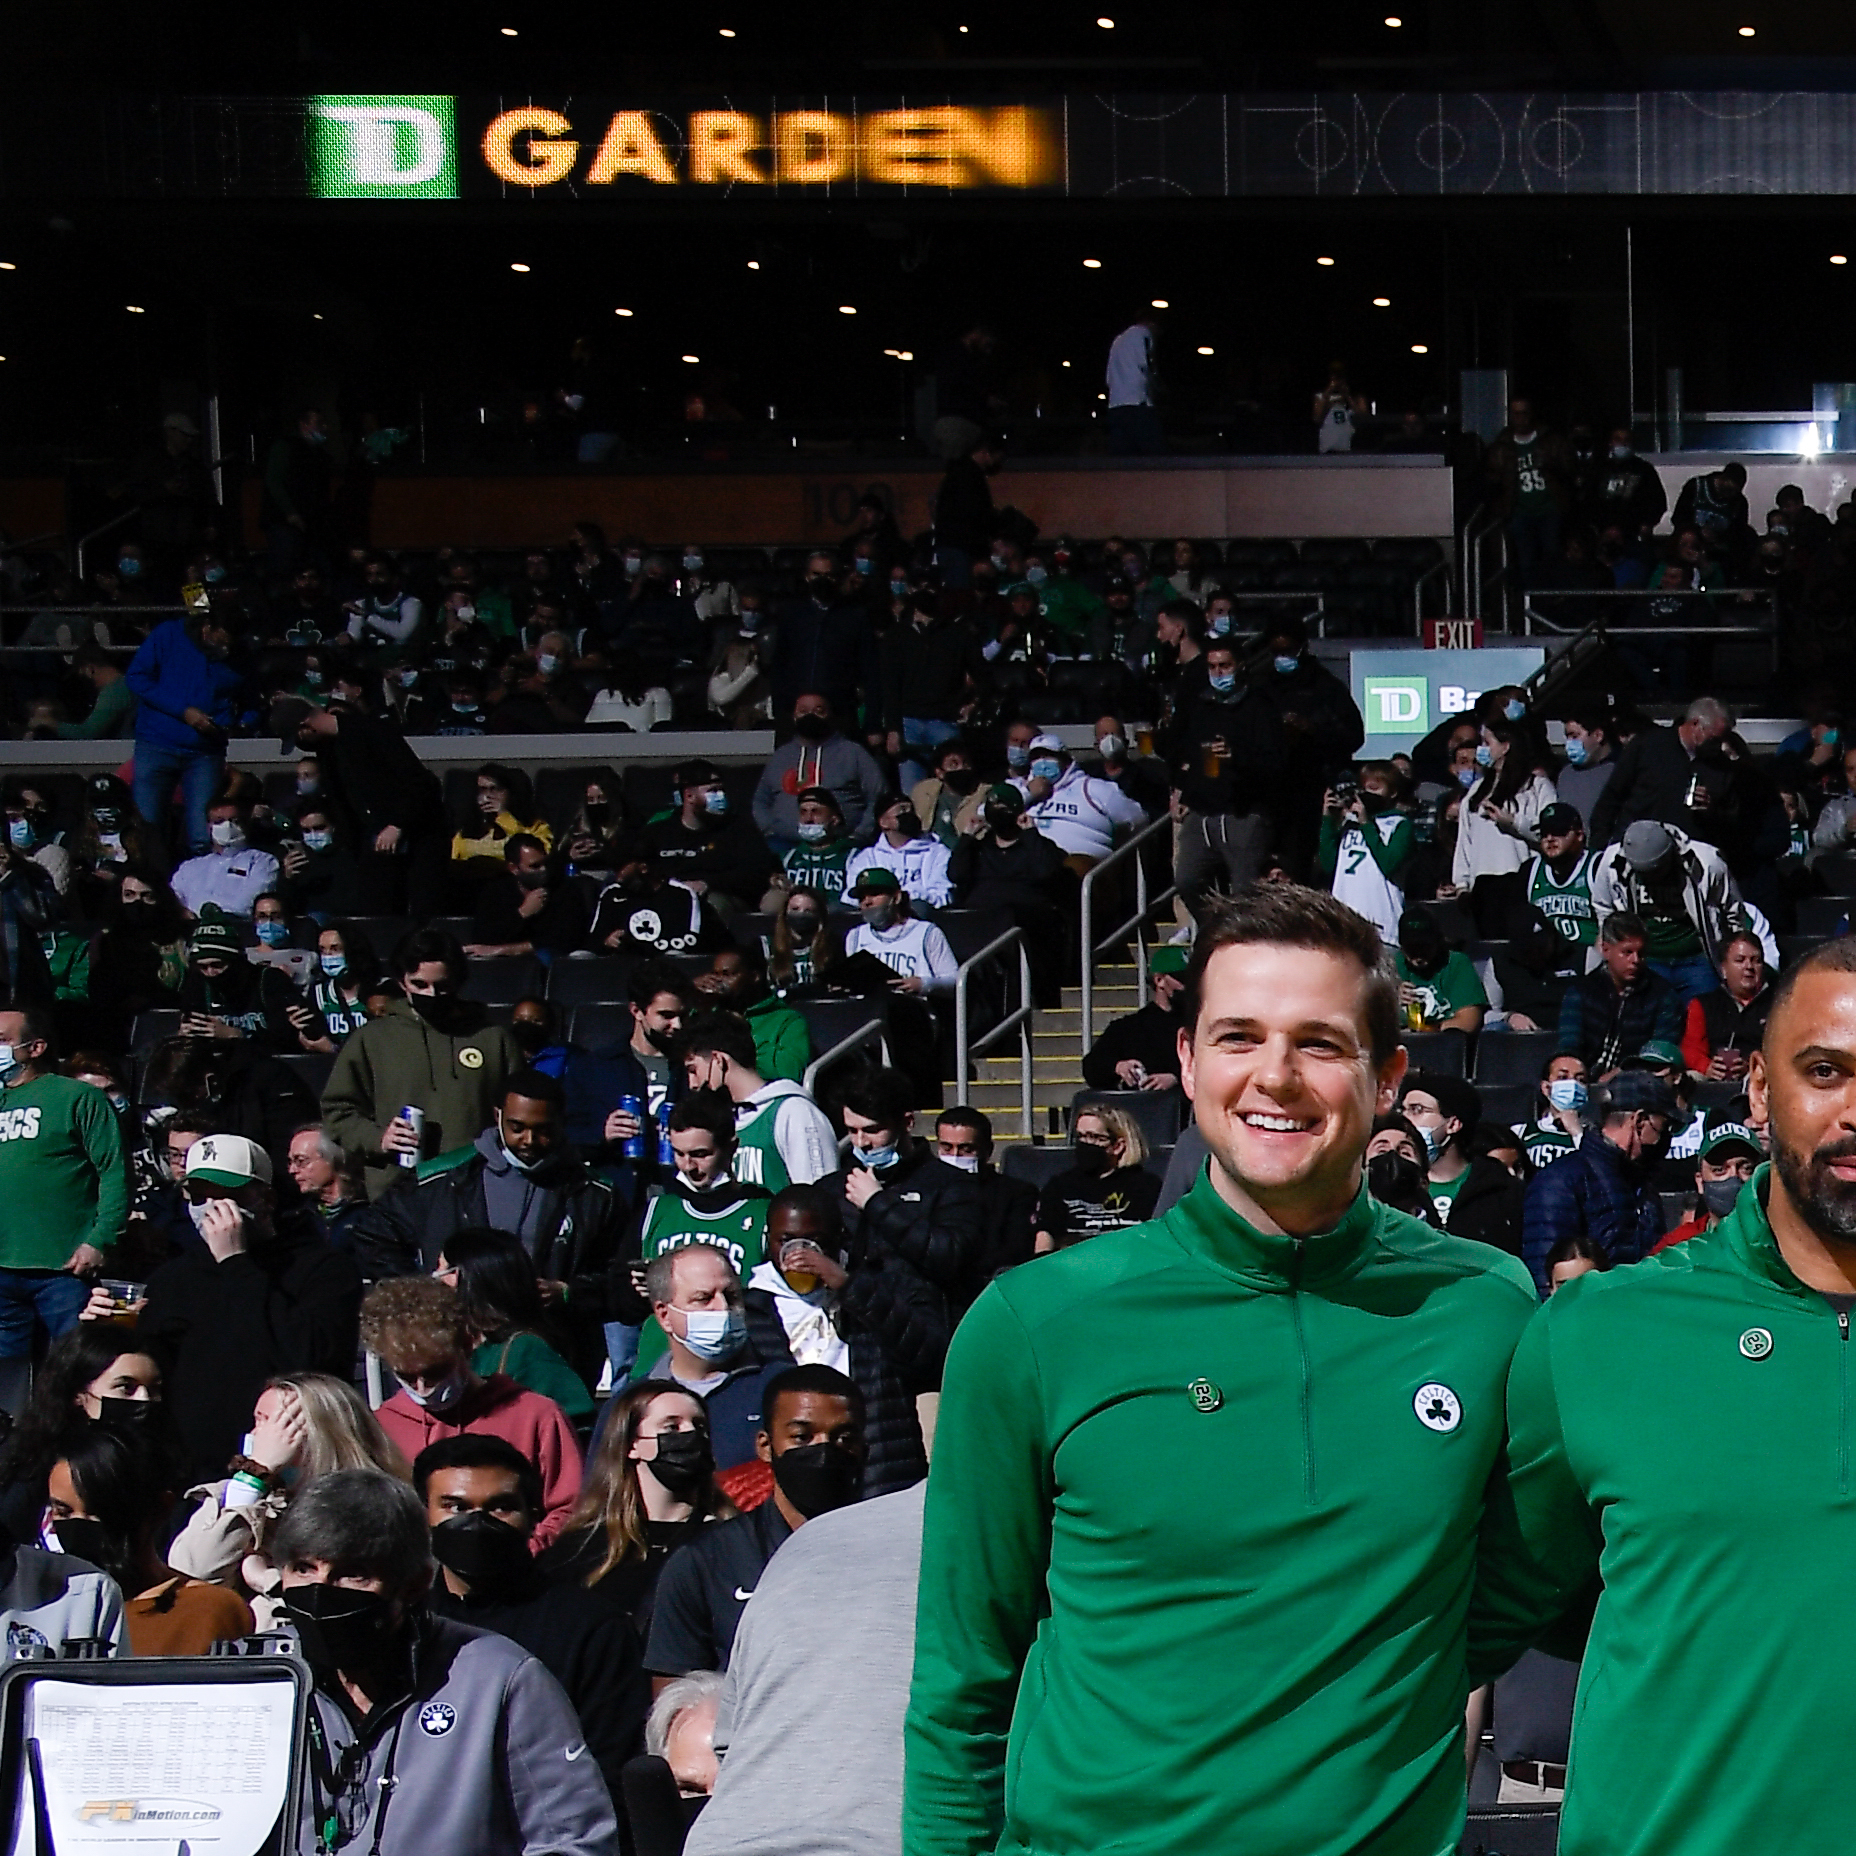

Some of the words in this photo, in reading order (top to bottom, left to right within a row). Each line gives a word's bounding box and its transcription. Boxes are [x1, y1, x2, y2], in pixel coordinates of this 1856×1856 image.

[316, 103, 449, 185] TD
[481, 104, 1054, 188] GARDEN
[1434, 621, 1475, 650] EXIT
[1370, 687, 1421, 722] TD
[1440, 686, 1482, 713] Ba
[1345, 850, 1367, 874] 7
[1194, 1383, 1213, 1406] 24
[1417, 1387, 1457, 1408] CELTICS
